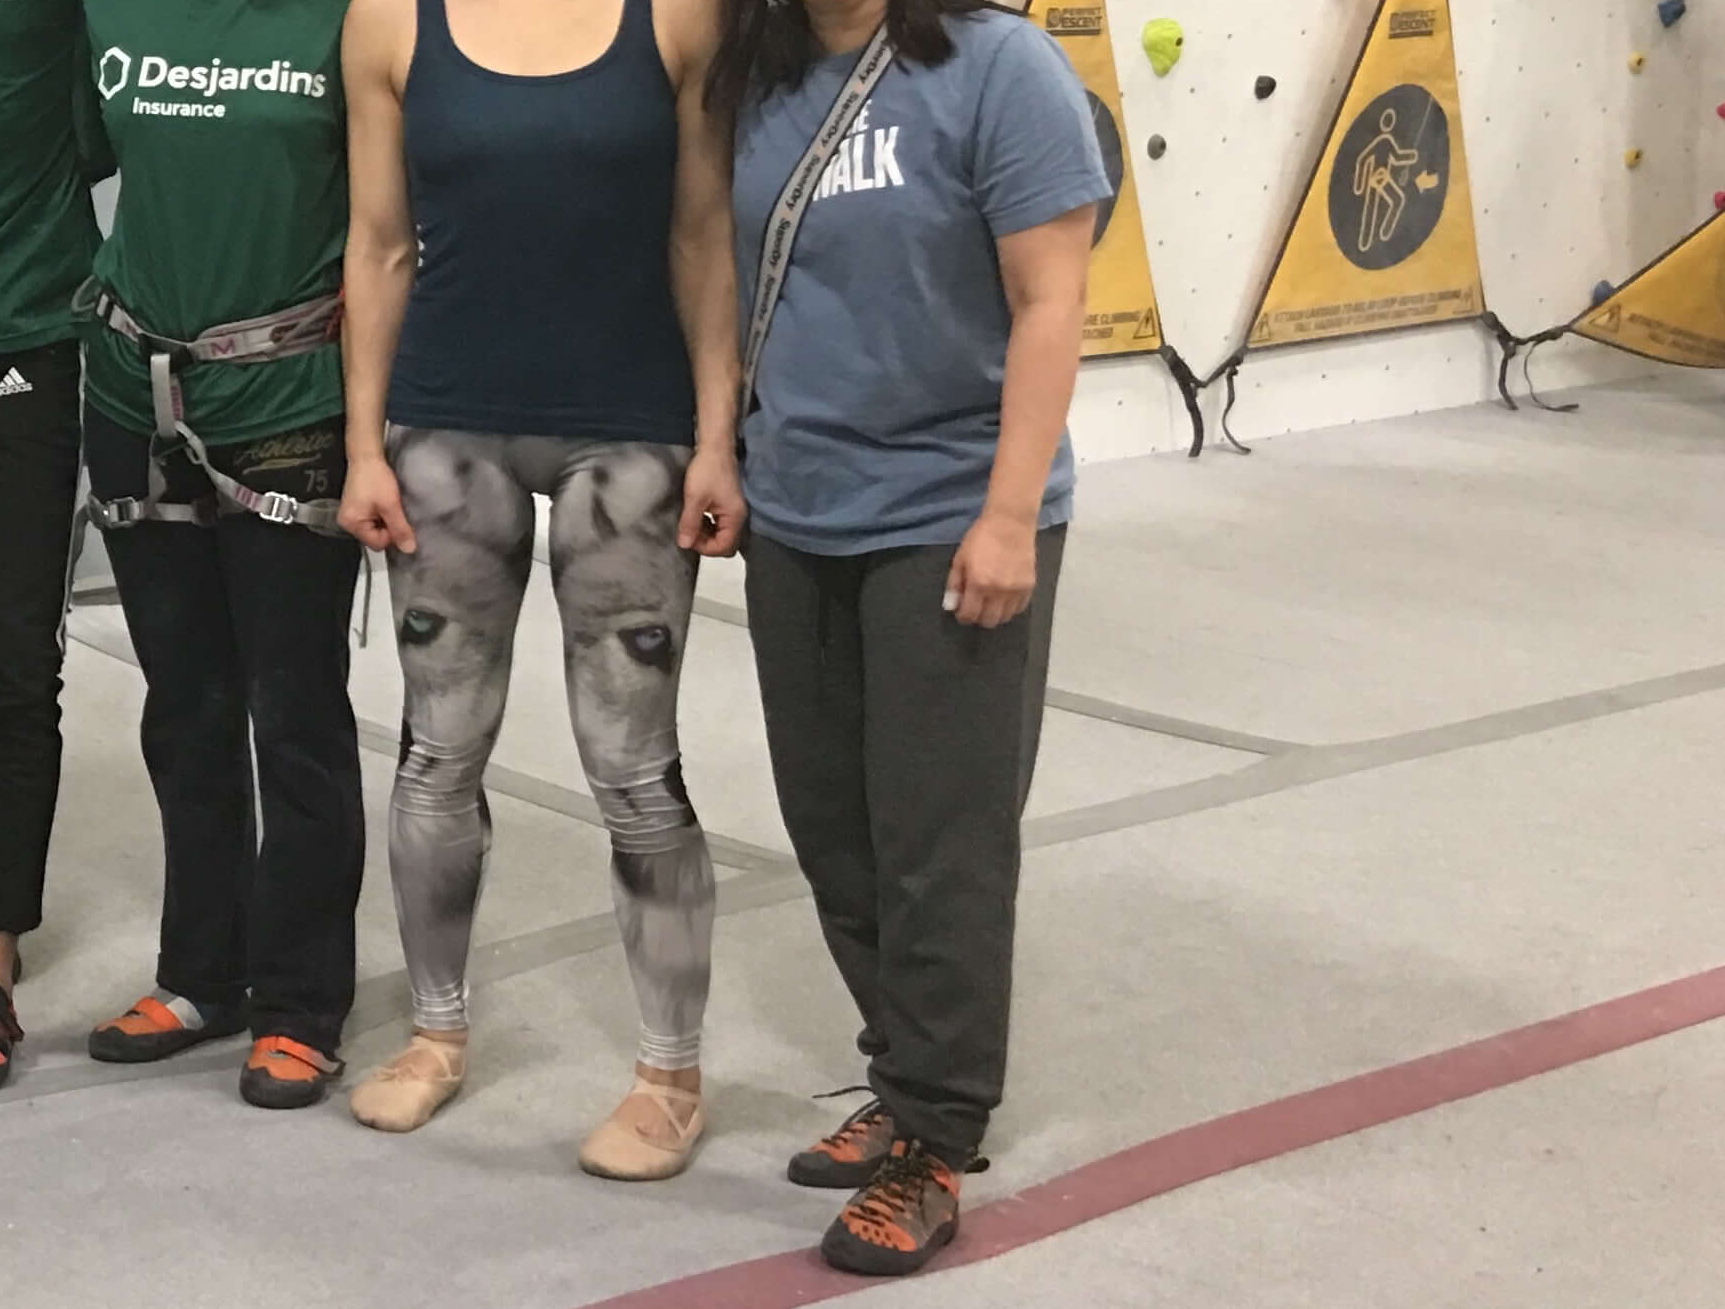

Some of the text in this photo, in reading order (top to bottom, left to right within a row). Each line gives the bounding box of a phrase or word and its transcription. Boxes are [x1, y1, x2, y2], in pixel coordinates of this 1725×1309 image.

[138, 56, 326, 98] Desjardins
[132, 97, 226, 118] Insurance
[304, 469, 329, 493] 75
